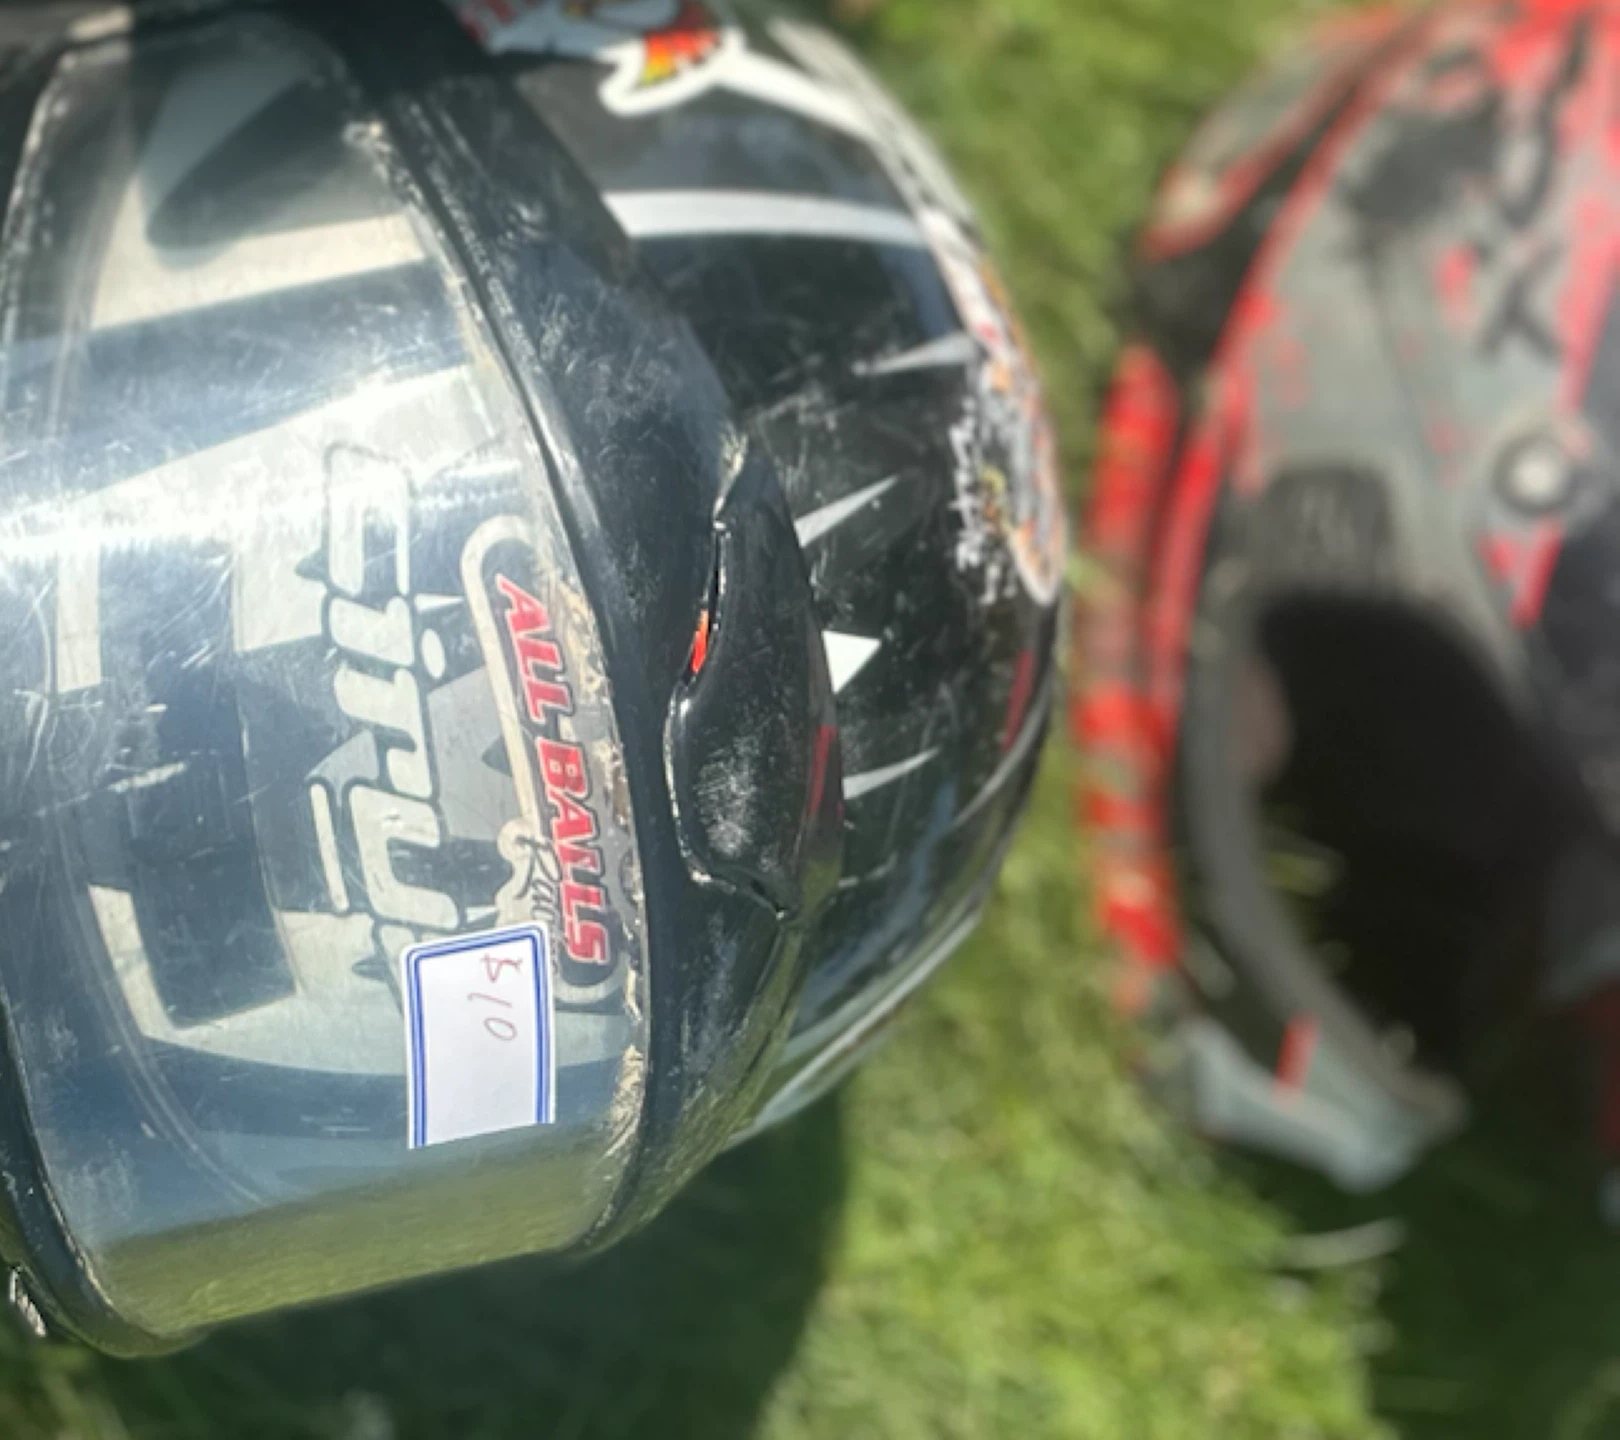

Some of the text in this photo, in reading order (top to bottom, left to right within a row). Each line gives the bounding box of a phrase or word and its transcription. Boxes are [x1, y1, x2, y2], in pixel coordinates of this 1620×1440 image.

[494, 573, 611, 966] ALL BALLS
[468, 950, 523, 1043] $10
